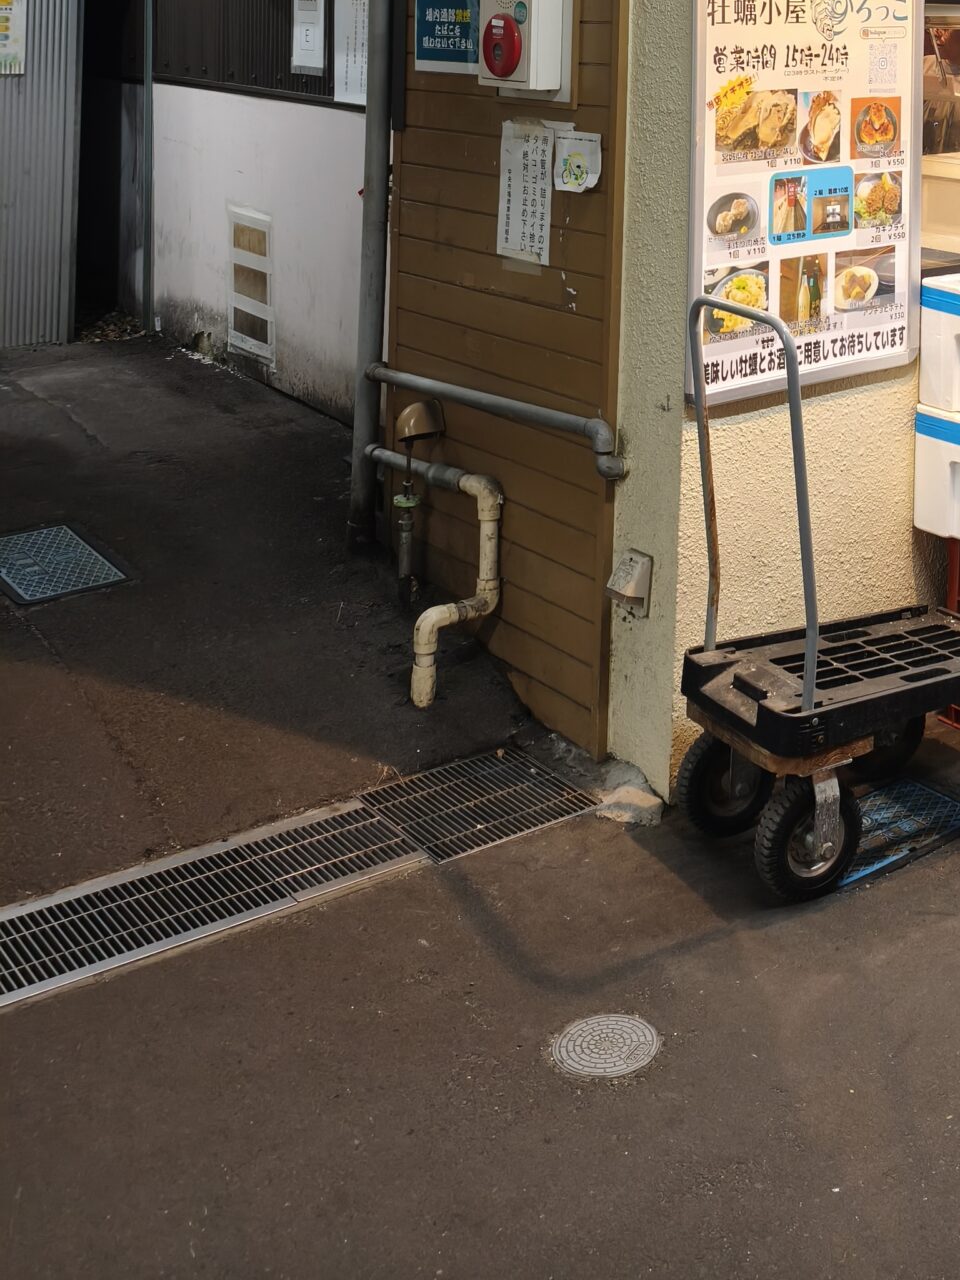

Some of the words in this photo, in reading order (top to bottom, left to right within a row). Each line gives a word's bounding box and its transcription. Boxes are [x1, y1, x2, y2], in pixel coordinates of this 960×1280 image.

[435, 24, 461, 36] たばこを
[713, 43, 777, 74] 営業時間
